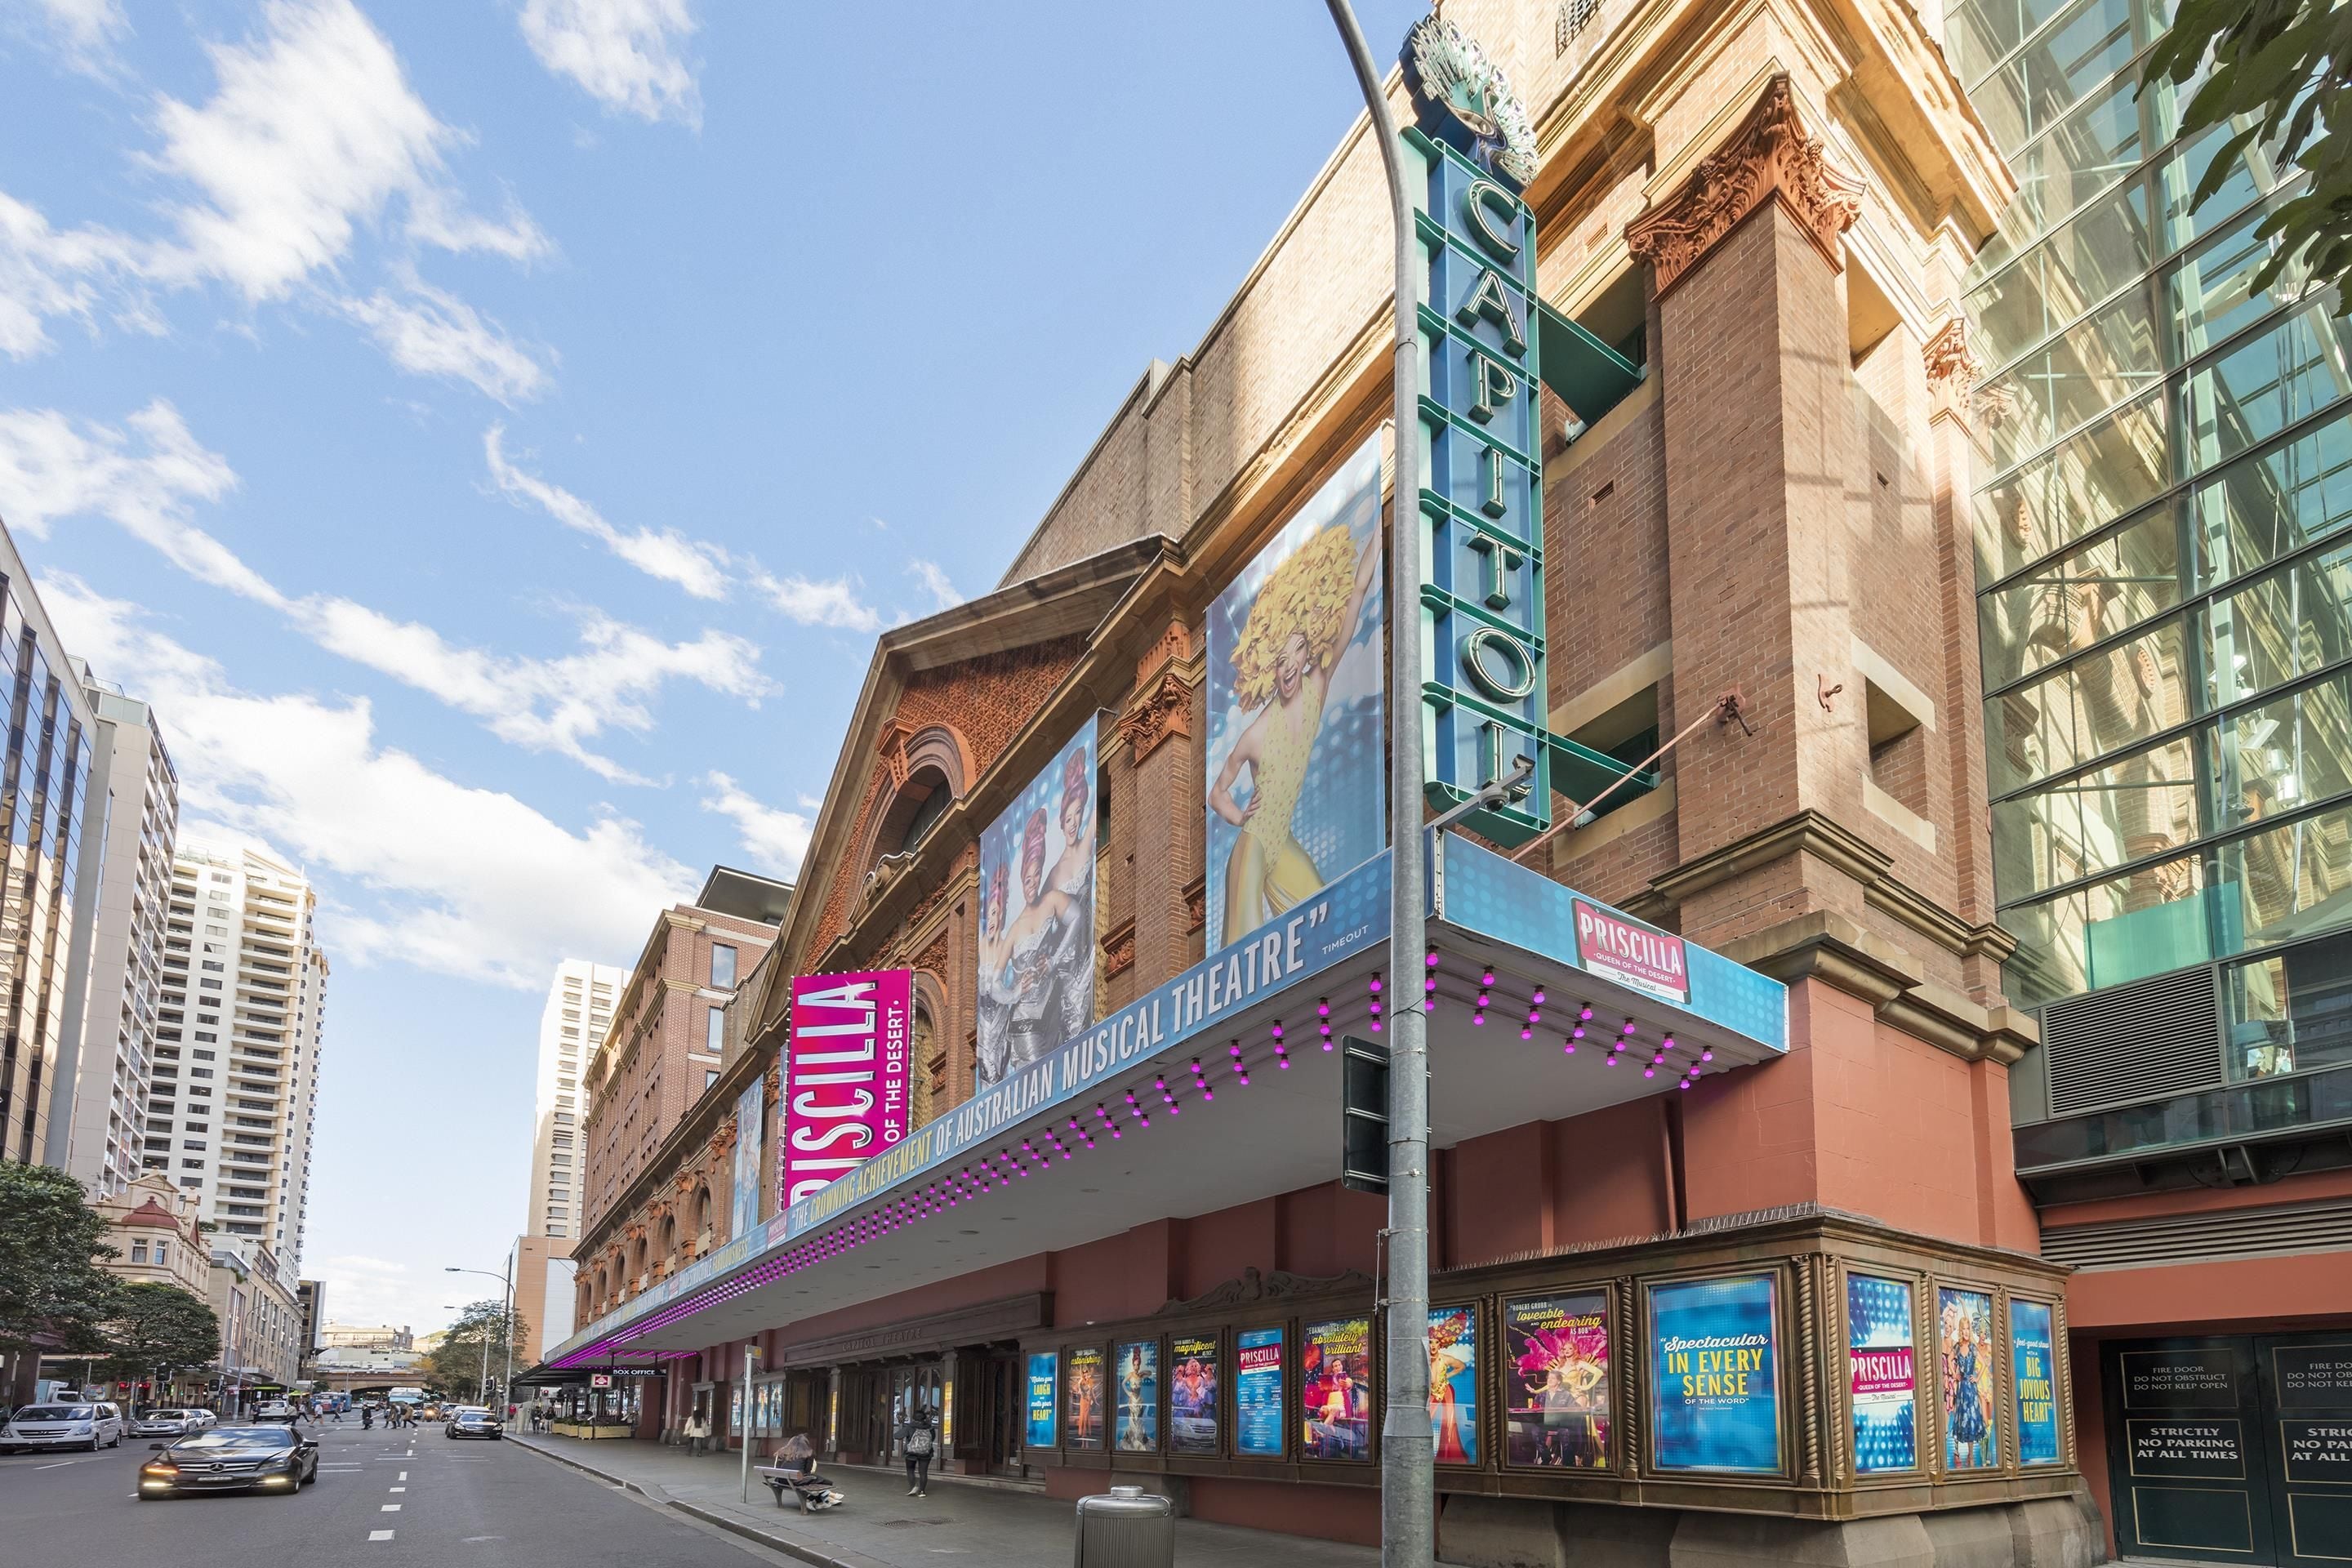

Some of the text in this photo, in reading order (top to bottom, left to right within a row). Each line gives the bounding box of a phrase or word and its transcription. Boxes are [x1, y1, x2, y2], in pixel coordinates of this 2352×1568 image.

[1456, 177, 1537, 802] CAPITOL
[1322, 924, 1369, 955] TIMEOUT
[1580, 912, 1682, 977] PRISCILLA
[1622, 961, 1632, 969] OF
[1633, 965, 1647, 974] THE
[1617, 972, 1656, 991] The Musical
[885, 1078, 902, 1113] THE
[809, 1176, 856, 1223] CROWNING
[856, 1130, 933, 1200] ACHIEVEMENT
[935, 1116, 954, 1157] OF
[956, 1059, 1054, 1147] AUSTRALIAN
[1062, 999, 1164, 1092] MUSICAL
[884, 1118, 901, 1143] OF
[1517, 1307, 1566, 1321] loveable
[1540, 1316, 1601, 1330] endearing
[842, 1326, 922, 1352] CAPITOL THEATRE
[1312, 1331, 1359, 1345] absolutely
[2016, 1338, 2038, 1350] feel-good
[1174, 1340, 1217, 1356] magnificent
[1241, 1348, 1279, 1364] PRISCILLA
[1668, 1348, 1763, 1374] IN EVERY
[1851, 1356, 1911, 1382] PRISCILLA
[2026, 1356, 2041, 1377] BIG
[1034, 1384, 1050, 1395] LAUGH
[1682, 1373, 1748, 1396] SENSE
[2020, 1379, 2051, 1400] JOYOUS
[2150, 1428, 2220, 1436] STRICTLY
[2138, 1438, 2235, 1448] NO PARKING
[2293, 1440, 2352, 1449] NO PA
[2137, 1450, 2238, 1459] AT ALL TIMES
[2292, 1452, 2350, 1462] AT ALL
